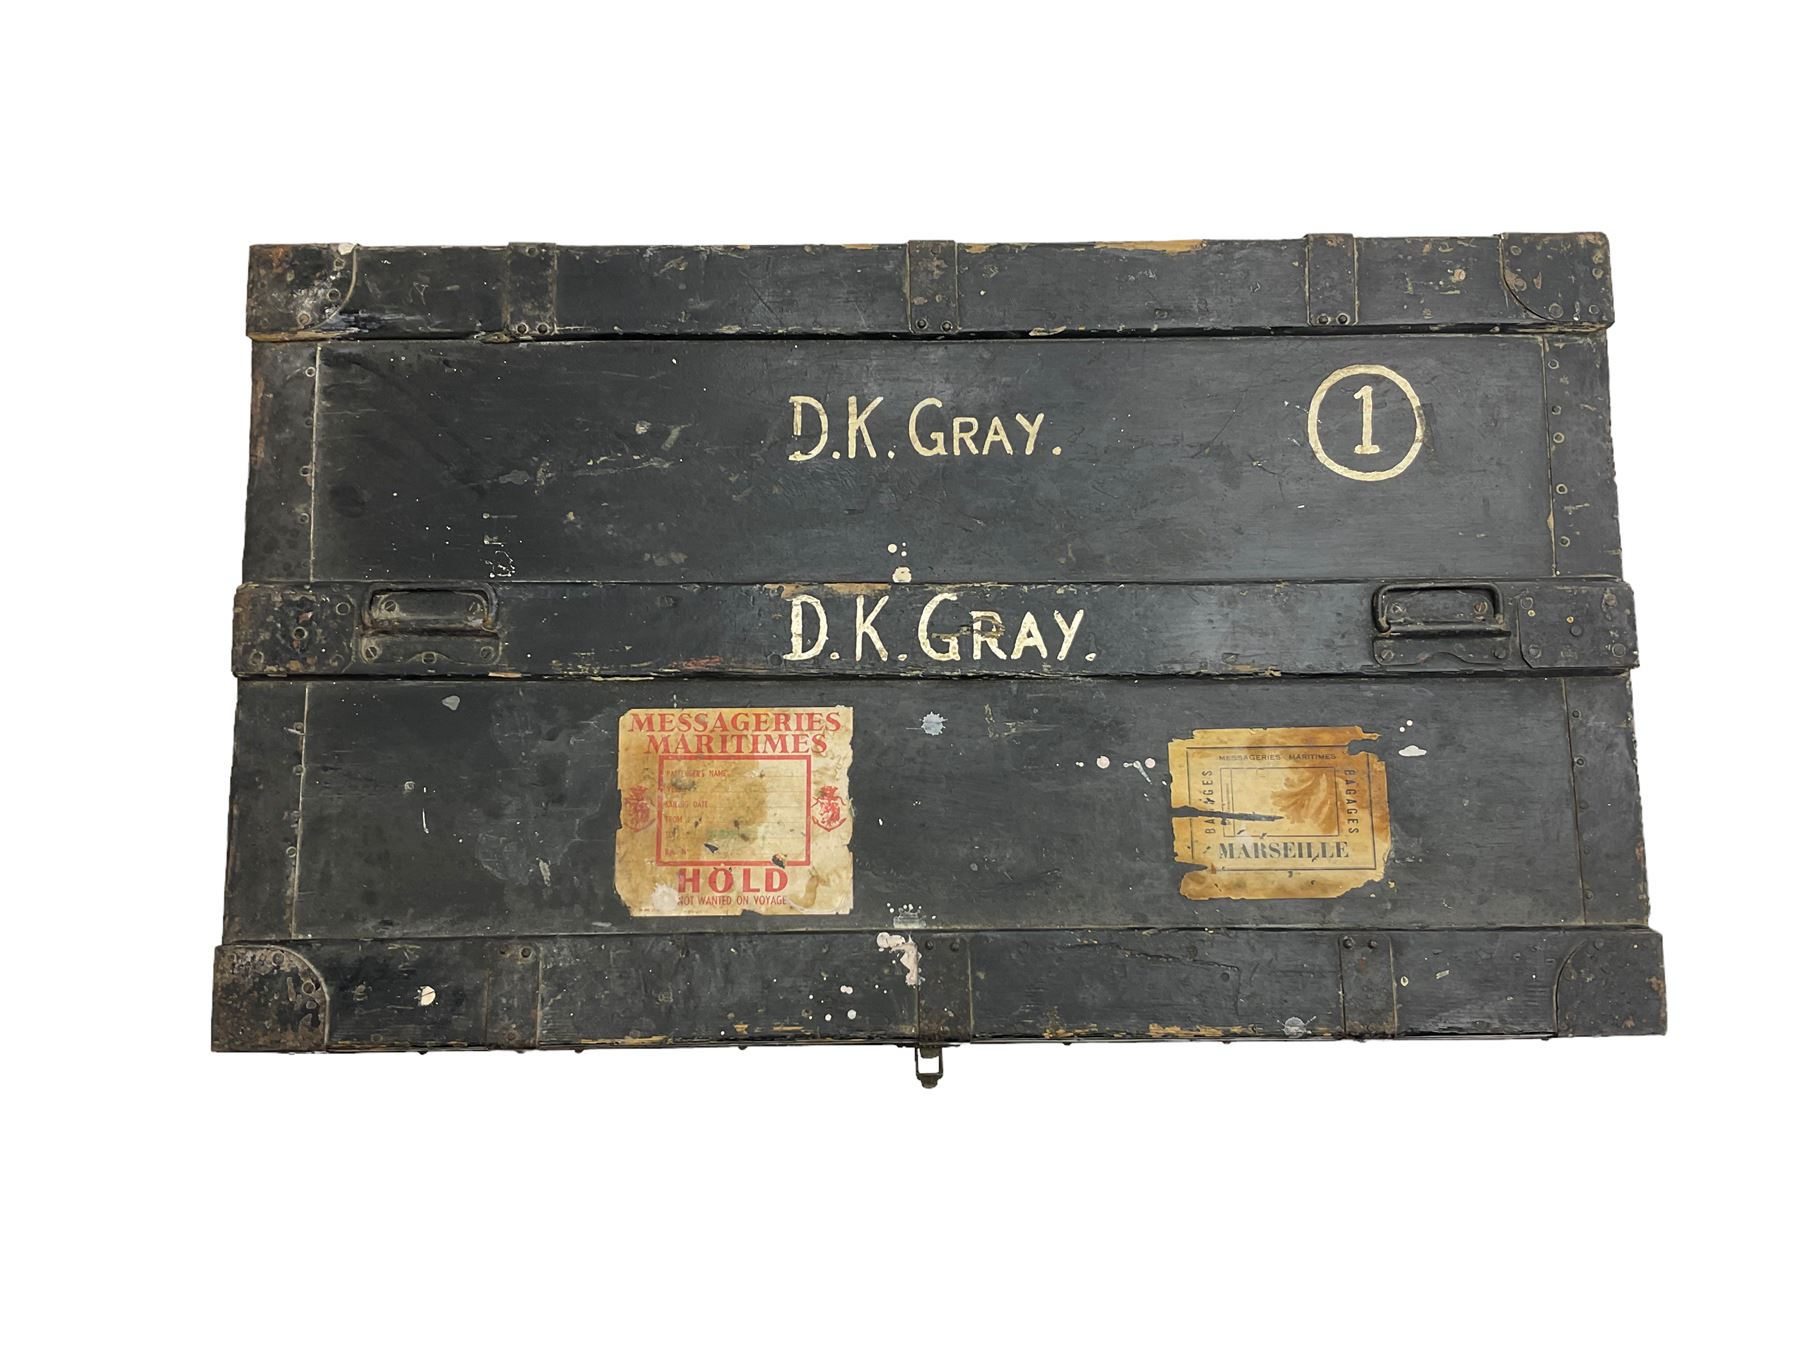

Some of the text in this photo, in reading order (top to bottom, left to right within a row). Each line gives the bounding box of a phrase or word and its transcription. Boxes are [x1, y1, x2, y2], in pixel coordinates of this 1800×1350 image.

[1353, 385, 1381, 455] 1
[628, 712, 842, 732] MESSAGERIES
[645, 733, 828, 754] MARITIMES
[1201, 770, 1216, 834] BAAGES
[1344, 769, 1360, 834] BAGAGES
[1219, 841, 1349, 860] MARSEILLE
[677, 868, 788, 893] HOLD
[678, 895, 786, 905] NOT WANTED ON VOYAGE
